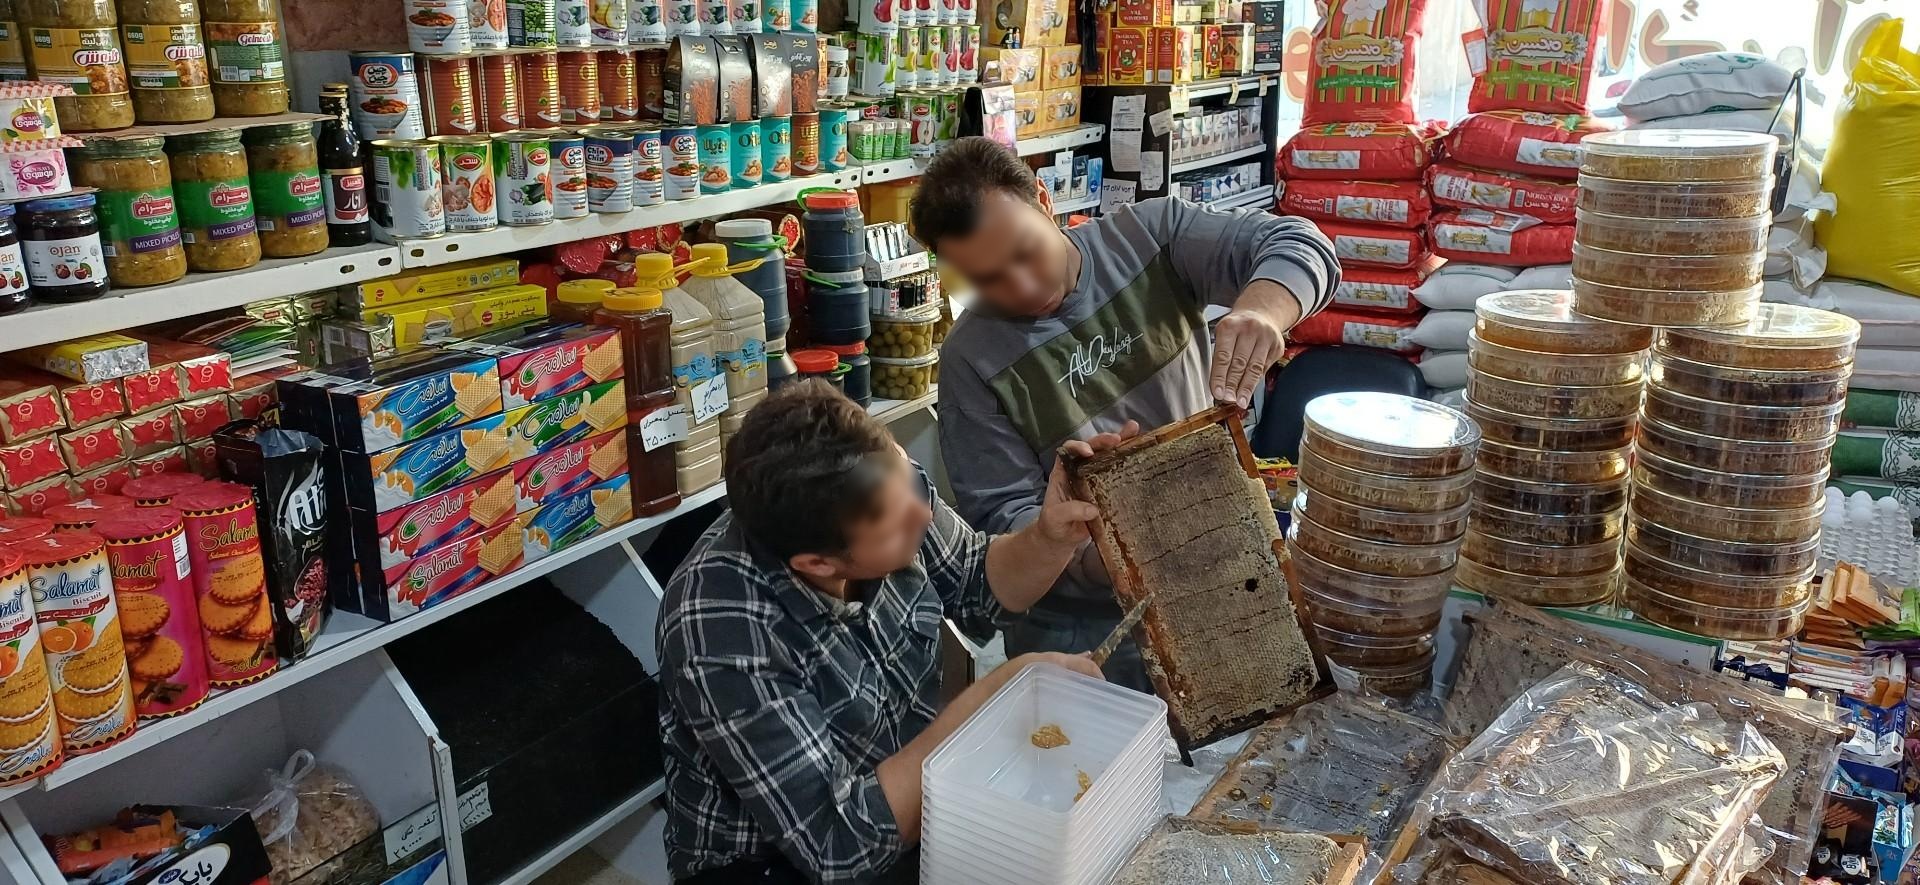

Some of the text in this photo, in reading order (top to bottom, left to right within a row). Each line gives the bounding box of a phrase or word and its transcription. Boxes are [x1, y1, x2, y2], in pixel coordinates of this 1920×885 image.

[343, 192, 361, 210] انار
[291, 213, 312, 224] MIXED
[212, 226, 237, 236] MIXED
[135, 238, 161, 249] MIXED
[200, 517, 258, 551] Salama
[111, 550, 168, 579] lamat
[413, 542, 467, 591] Salamat
[29, 563, 105, 605] Salamat
[72, 591, 103, 606] Biscuit
